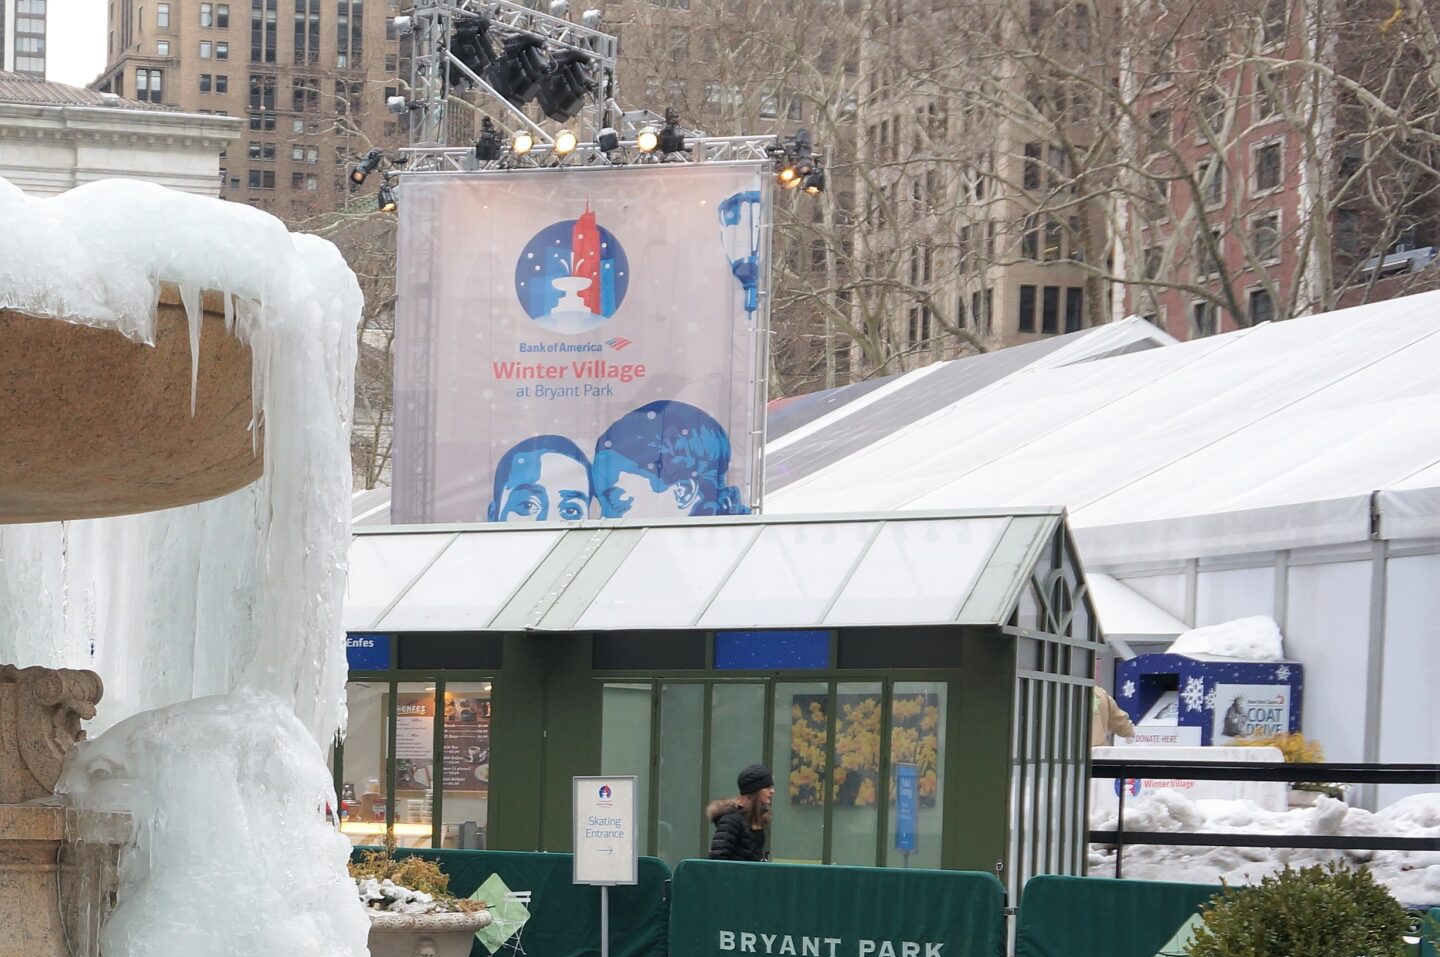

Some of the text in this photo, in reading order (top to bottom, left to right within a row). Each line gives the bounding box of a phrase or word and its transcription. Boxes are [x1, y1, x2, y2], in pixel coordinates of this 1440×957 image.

[519, 341, 603, 353] Bank of America
[492, 359, 647, 383] Winter Village
[516, 383, 615, 400] at Bryant Park
[346, 637, 375, 648] Enfes
[1247, 707, 1284, 723] COAT
[1135, 734, 1179, 744] DONATE HERE
[1144, 779, 1195, 790] Winter Village
[588, 815, 622, 829] Skating
[585, 828, 625, 839] Entrance
